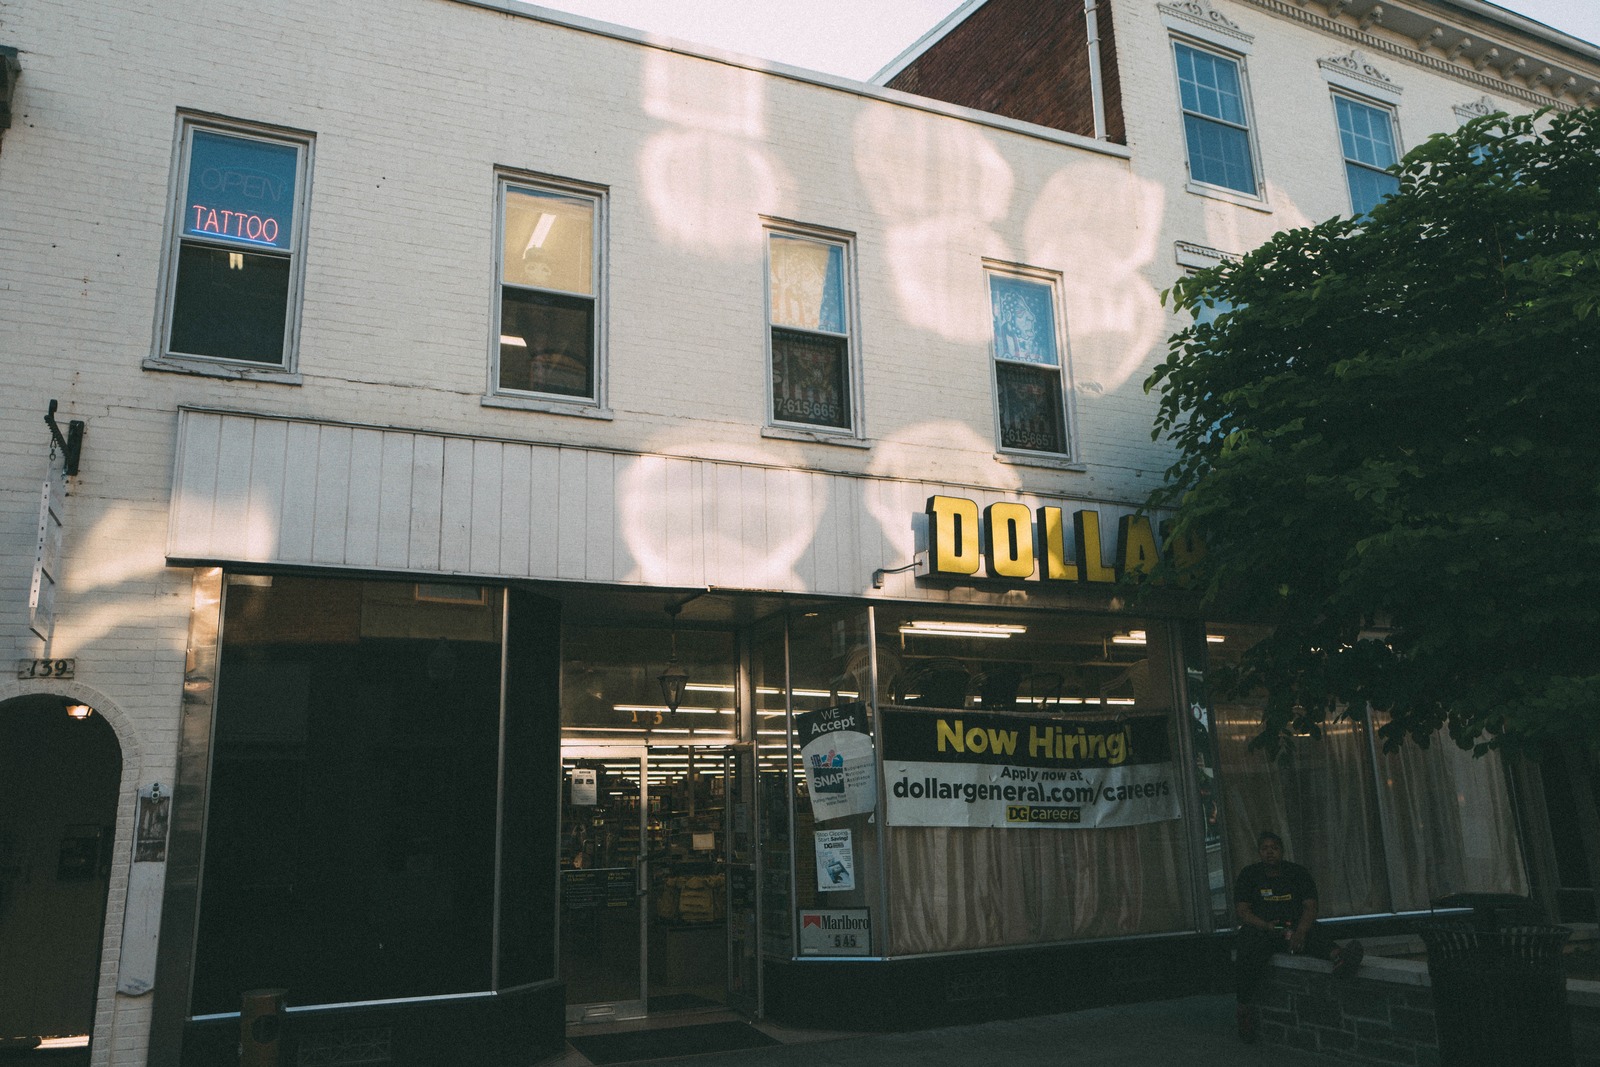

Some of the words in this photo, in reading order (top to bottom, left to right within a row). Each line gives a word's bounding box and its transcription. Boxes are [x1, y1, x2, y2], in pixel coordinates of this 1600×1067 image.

[201, 167, 283, 201] OPEN
[192, 205, 279, 242] TATTOO
[30, 659, 68, 677] 139
[821, 708, 840, 720] WE
[811, 715, 856, 735] Accept
[936, 719, 1018, 756] Now
[1028, 724, 1133, 765] Hiring!
[814, 772, 844, 788] SNAP
[1001, 766, 1038, 783] Apply
[1041, 770, 1066, 781] now
[1069, 769, 1083, 781] at
[893, 776, 1169, 805] dollargeneral.com/careers
[821, 915, 869, 930] Marlboro
